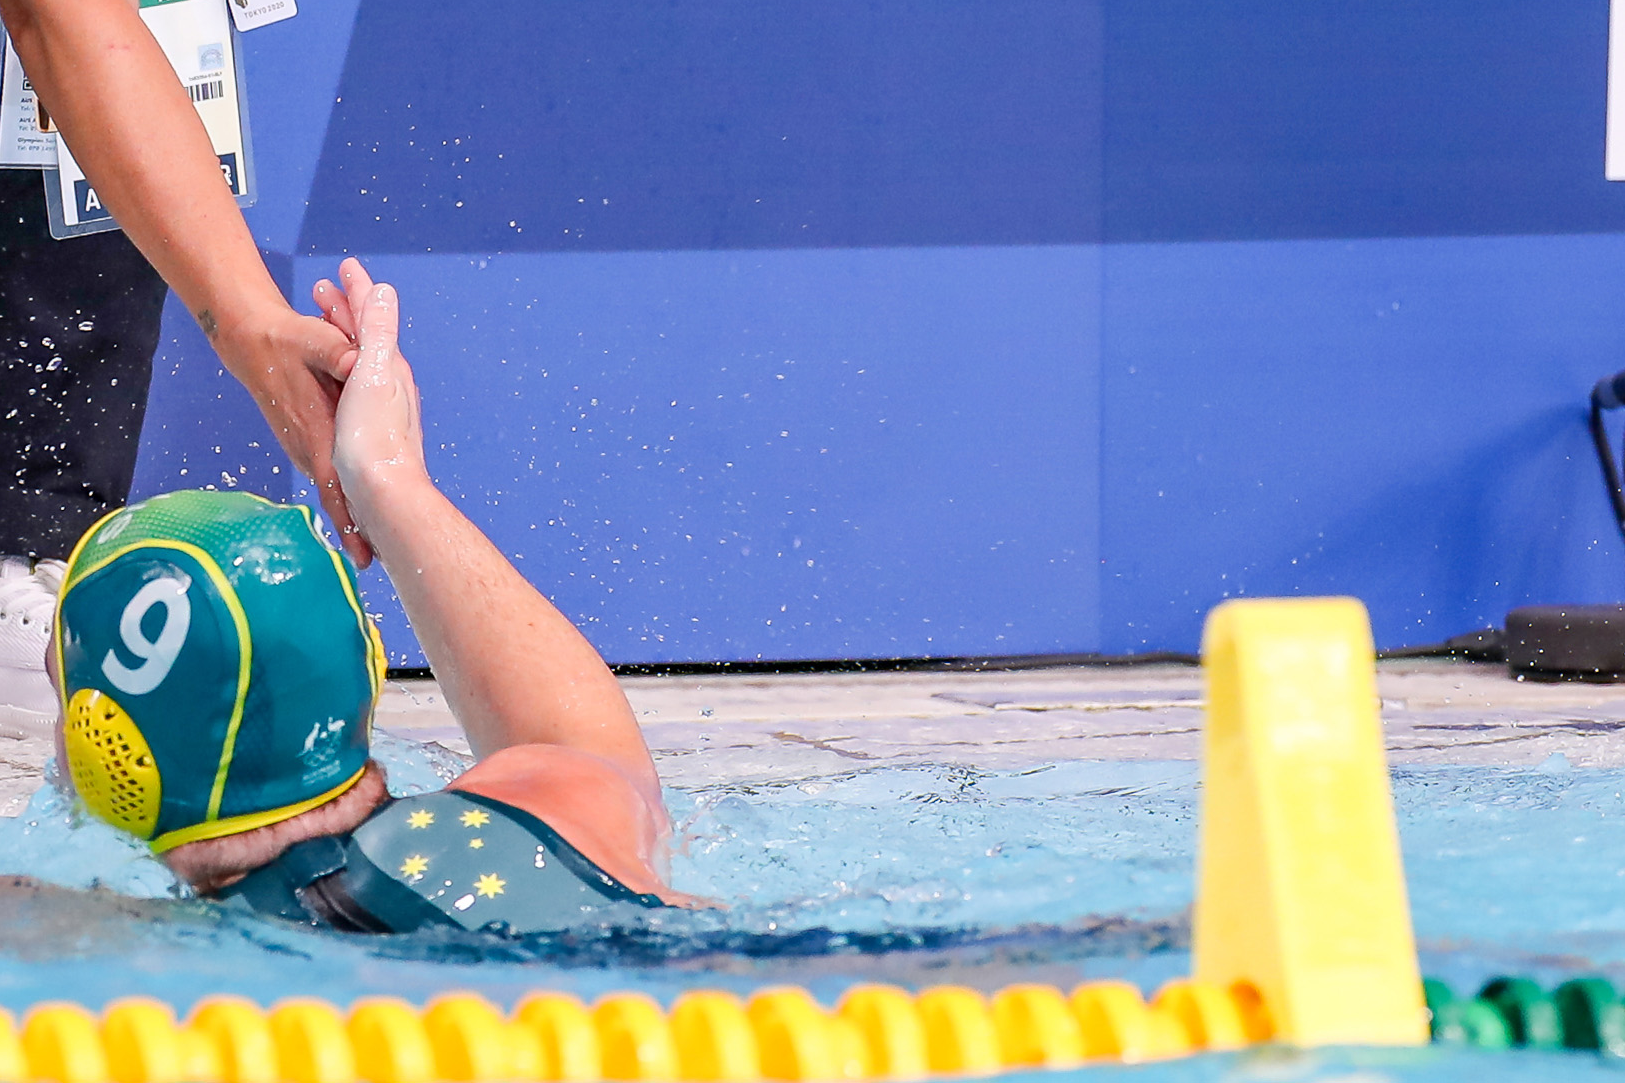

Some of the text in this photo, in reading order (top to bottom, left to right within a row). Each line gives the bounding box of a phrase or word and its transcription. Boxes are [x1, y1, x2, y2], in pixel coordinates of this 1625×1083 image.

[243, 1, 285, 19] TOKYO 2020
[85, 187, 102, 212] A
[101, 577, 191, 695] 9
